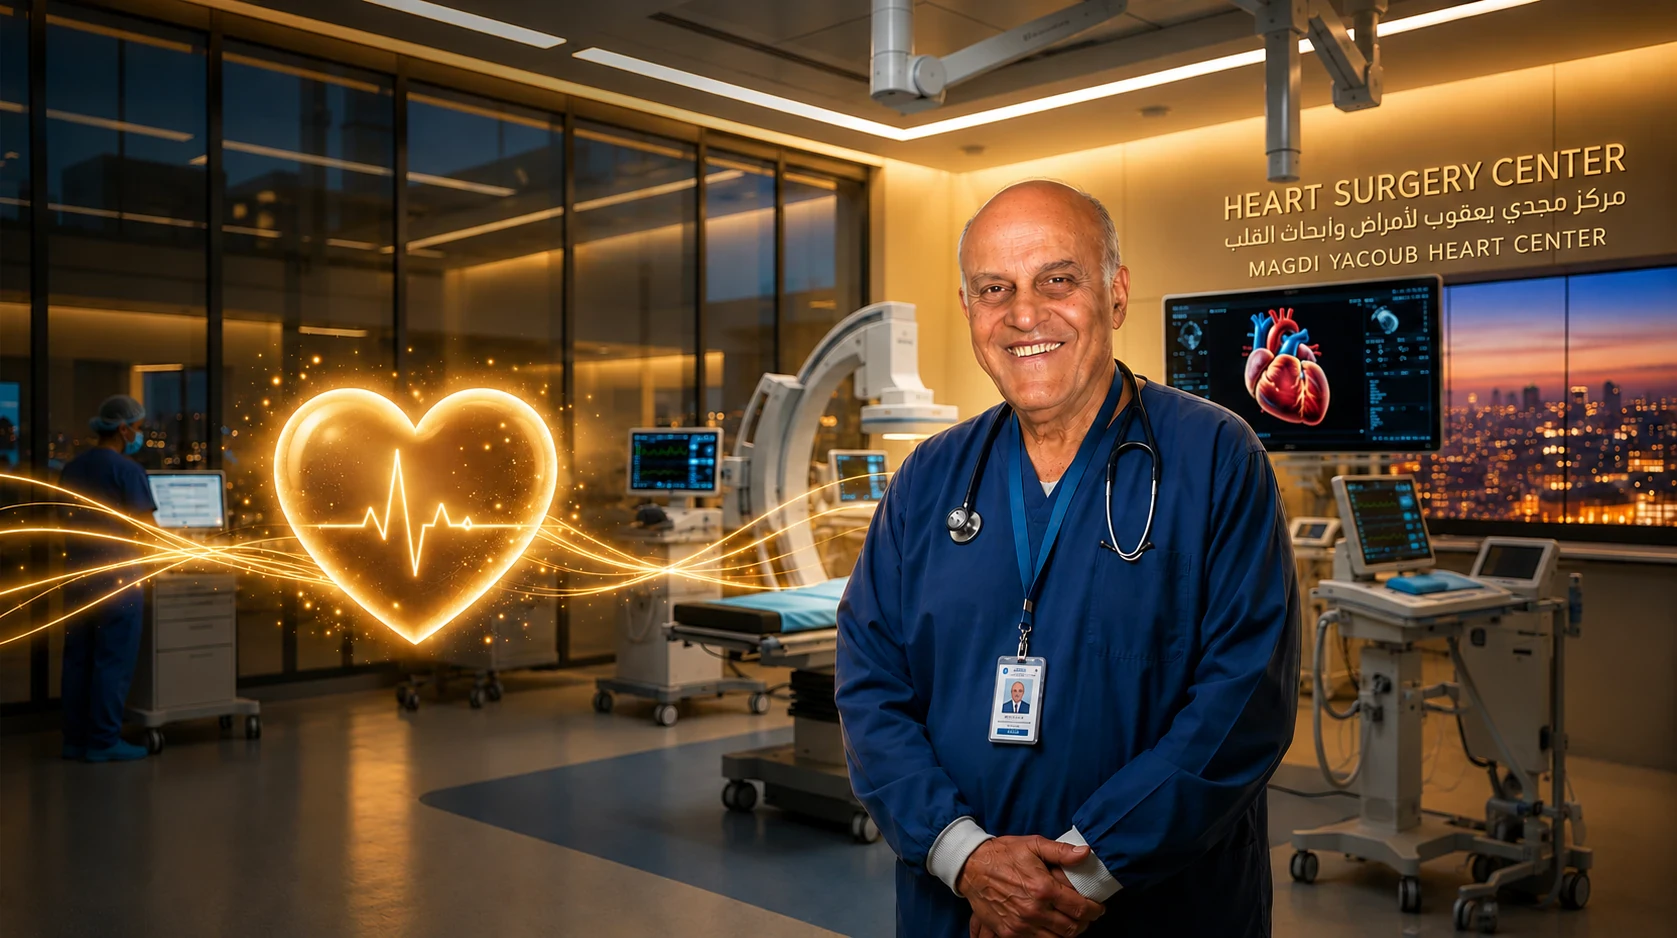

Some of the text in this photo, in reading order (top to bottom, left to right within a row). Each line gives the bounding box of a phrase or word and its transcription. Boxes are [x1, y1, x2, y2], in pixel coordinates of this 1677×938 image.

[1224, 143, 1626, 221] HEART SURGERY CENTER
[1502, 196, 1567, 224] مجدي
[1573, 187, 1626, 215] مركز
[1350, 206, 1417, 239] لأمراض
[1424, 204, 1495, 230] يعقوب
[1224, 225, 1275, 251] القلب
[1249, 227, 1606, 278] MAGDI YACOUB HEART CENTER
